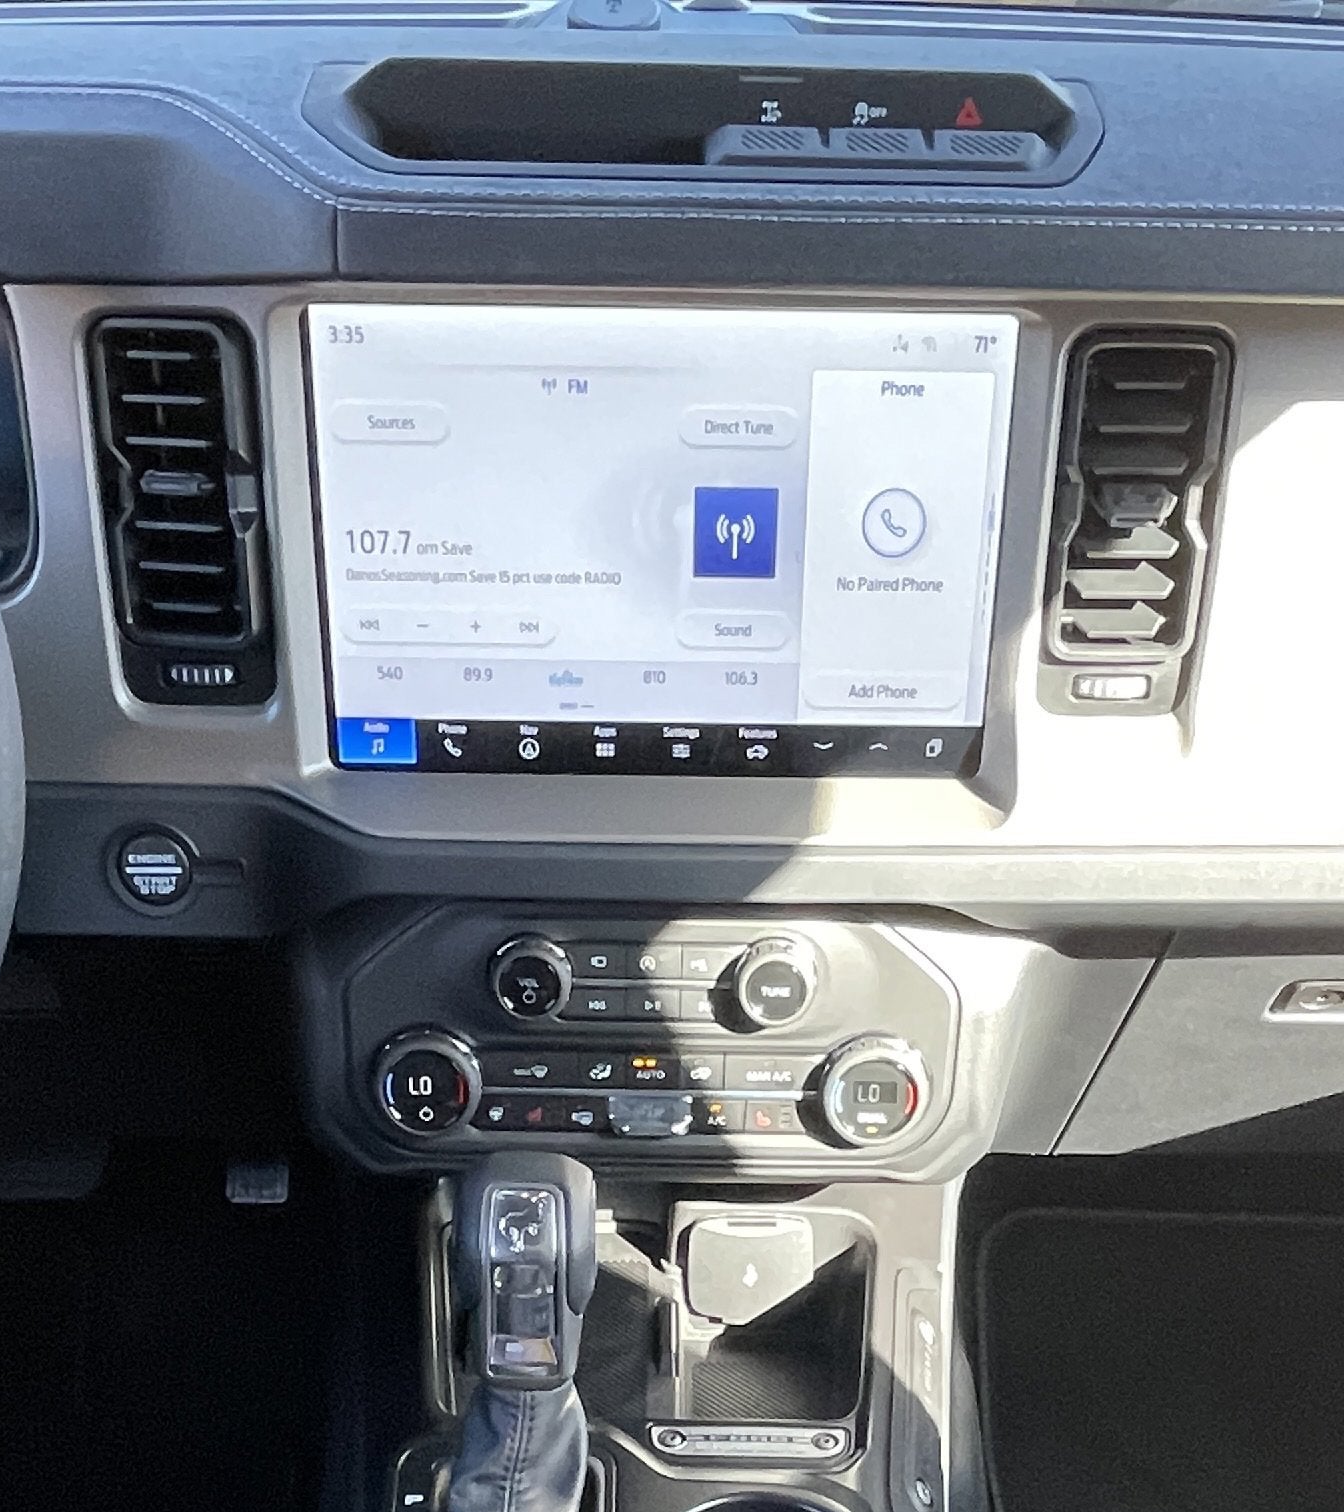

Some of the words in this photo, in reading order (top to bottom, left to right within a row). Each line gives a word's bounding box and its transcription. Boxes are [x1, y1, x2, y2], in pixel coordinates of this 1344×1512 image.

[328, 325, 365, 344] 3:35
[567, 379, 589, 395] FM
[881, 381, 925, 398] Phone
[367, 415, 416, 431] Sources
[704, 420, 740, 435] Direct
[744, 420, 774, 437] Tune
[345, 529, 412, 556] 107.7
[441, 541, 473, 557] Save
[469, 570, 497, 584] Save
[533, 573, 553, 585] use
[554, 571, 582, 585] code
[836, 576, 855, 592] No
[857, 576, 899, 592] Paired
[901, 577, 944, 594] Phone
[714, 622, 752, 638] Sound
[377, 665, 404, 681] 540
[463, 666, 494, 682] 89.9
[724, 670, 759, 687] 106.3
[848, 684, 873, 699] Add
[876, 684, 918, 701] Phone
[635, 1069, 666, 1081] AUTO
[408, 1075, 433, 1096] LO
[857, 1083, 881, 1104] LO
